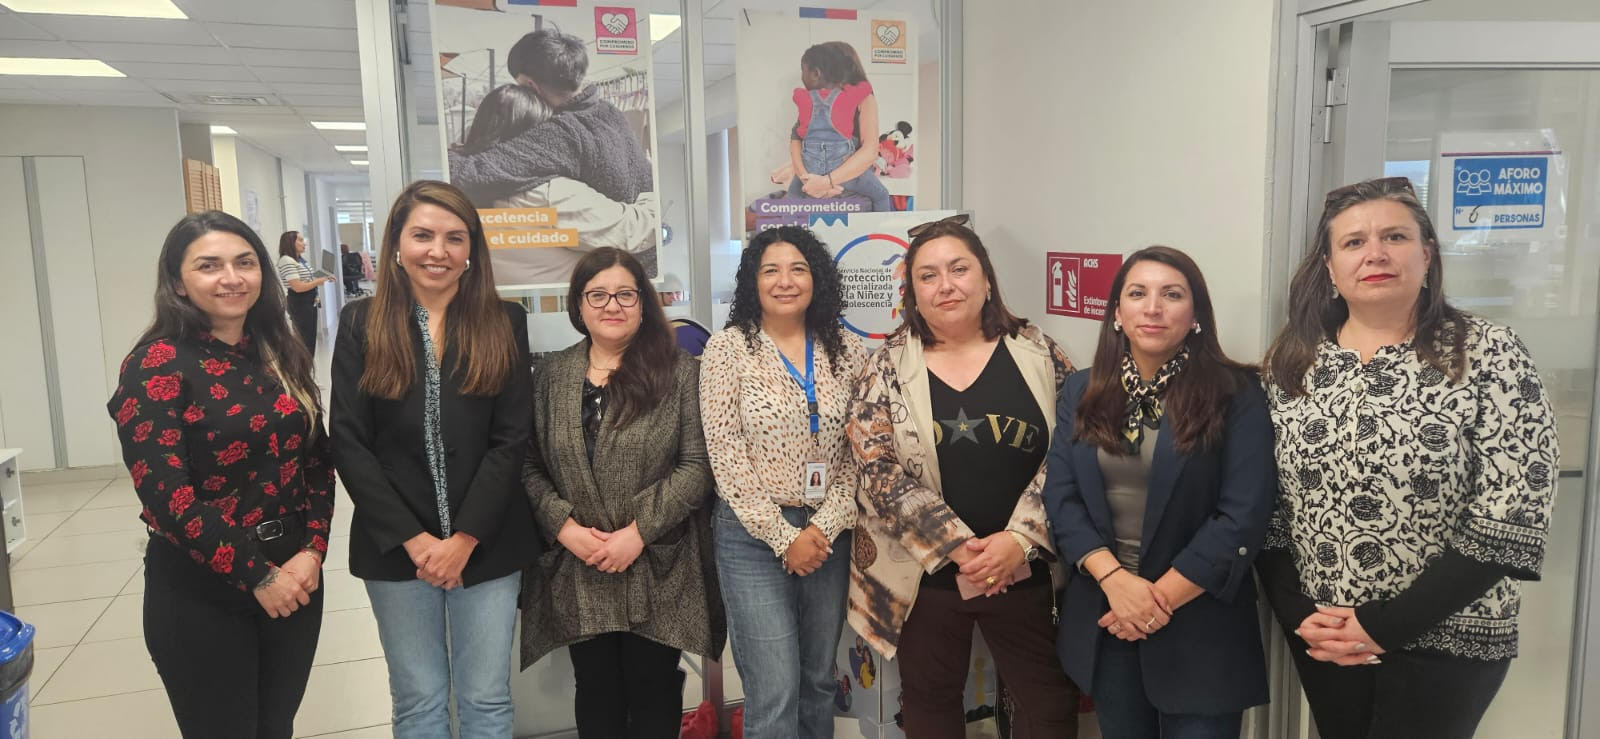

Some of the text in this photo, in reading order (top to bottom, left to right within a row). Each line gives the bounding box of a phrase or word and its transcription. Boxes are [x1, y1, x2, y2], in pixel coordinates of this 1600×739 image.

[1499, 167, 1540, 179] AFORO
[1493, 179, 1544, 195] MÁXIMO
[761, 201, 861, 215] Comprometidos
[480, 211, 549, 224] xcelencia
[1494, 213, 1540, 223] PERSONAS
[490, 231, 569, 244] el cuidado
[840, 283, 893, 291] specializada
[857, 290, 885, 300] Niñez
[887, 292, 893, 301] y
